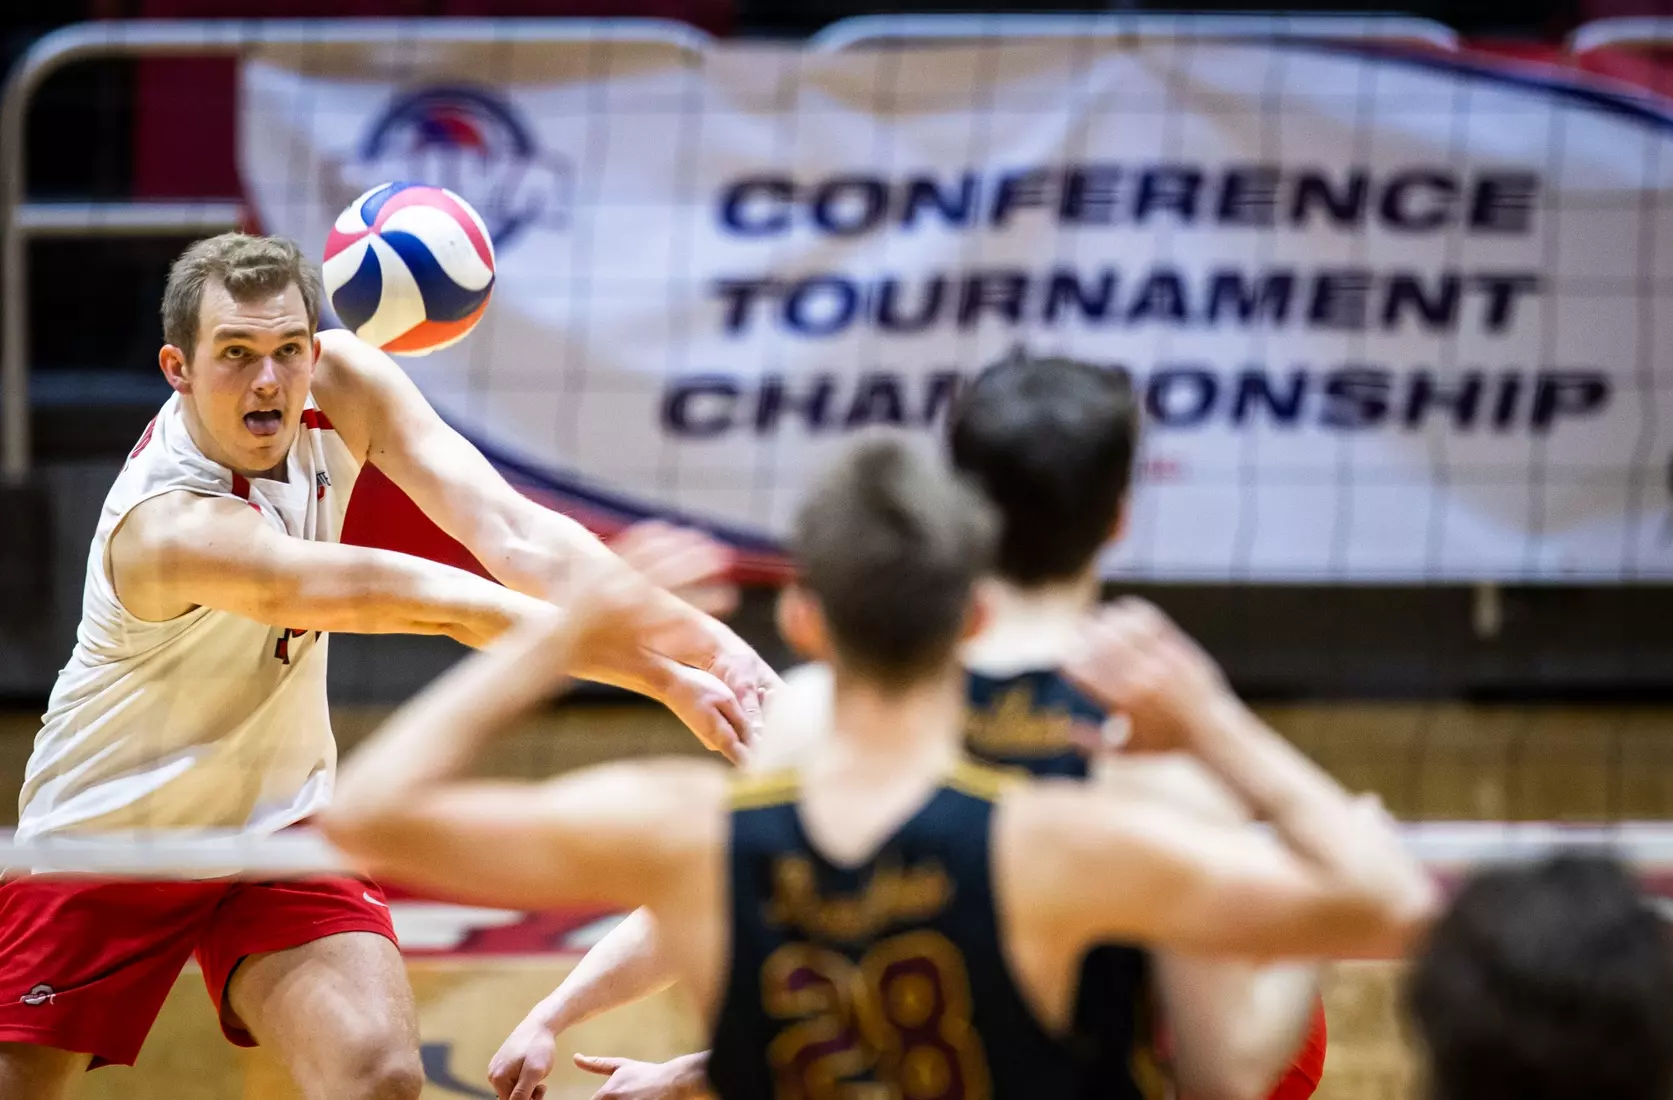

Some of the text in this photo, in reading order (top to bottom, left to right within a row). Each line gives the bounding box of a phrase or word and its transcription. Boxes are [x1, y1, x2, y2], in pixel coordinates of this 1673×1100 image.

[717, 165, 1541, 236] CONFERENCE
[713, 270, 1546, 335] TOURNAMENT
[661, 367, 1612, 437] CHAONSHIP
[762, 932, 993, 1100] 28
